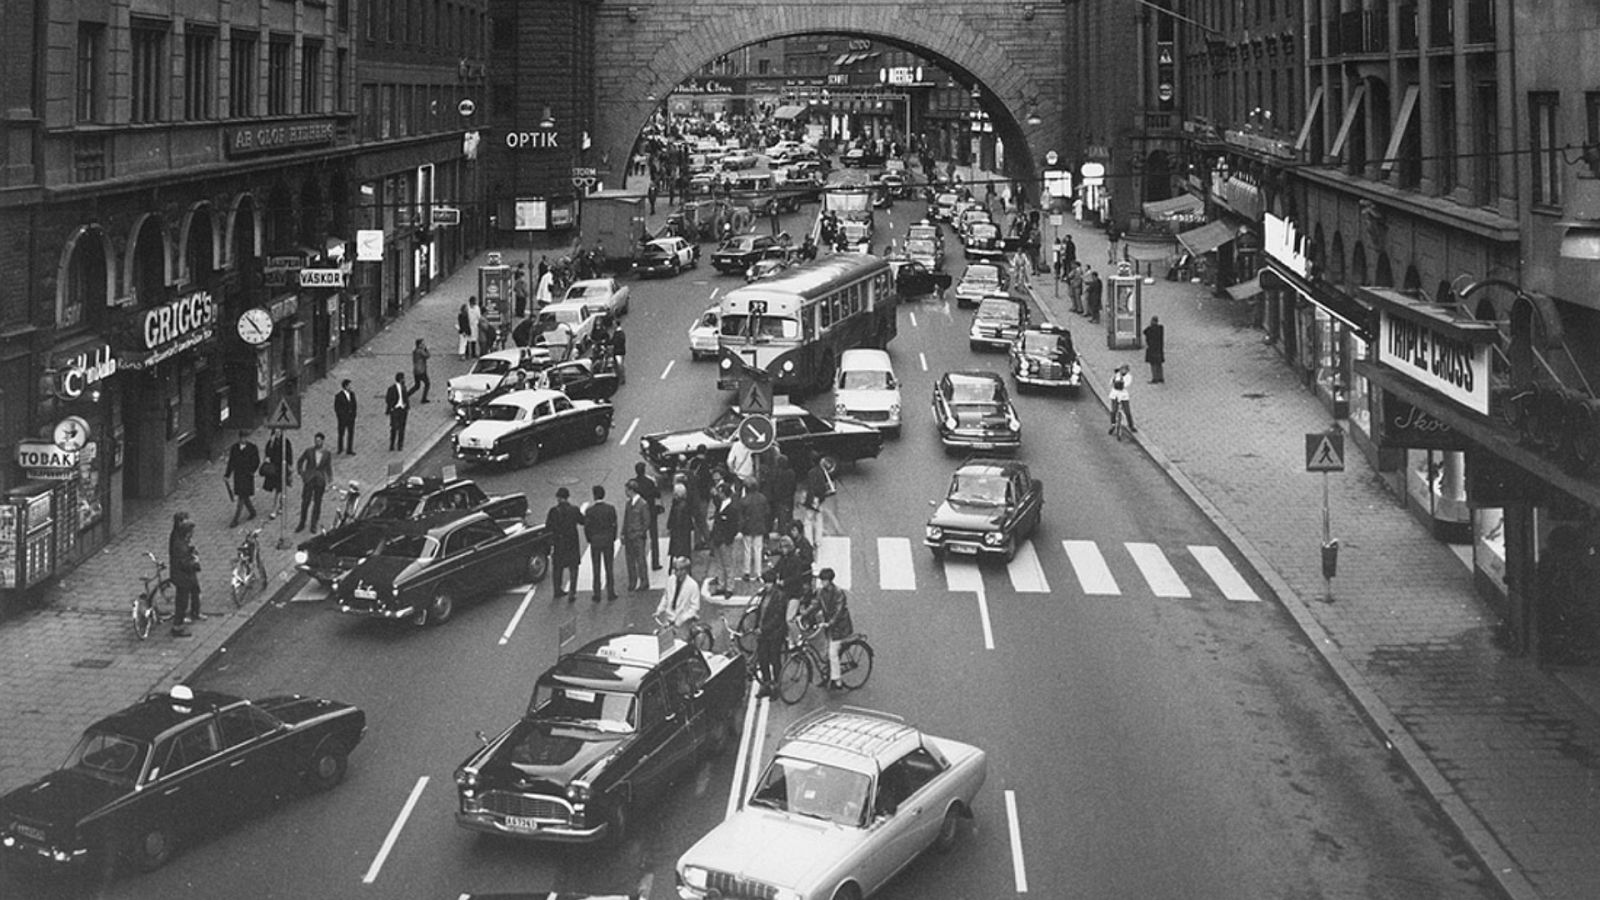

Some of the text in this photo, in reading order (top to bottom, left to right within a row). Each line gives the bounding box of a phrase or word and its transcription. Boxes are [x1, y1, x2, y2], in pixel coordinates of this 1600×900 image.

[506, 132, 558, 147] OPTIK
[301, 271, 341, 283] VÄSKOR
[1387, 314, 1474, 393] TRIPLE CROSS
[20, 452, 72, 466] TOBAK
